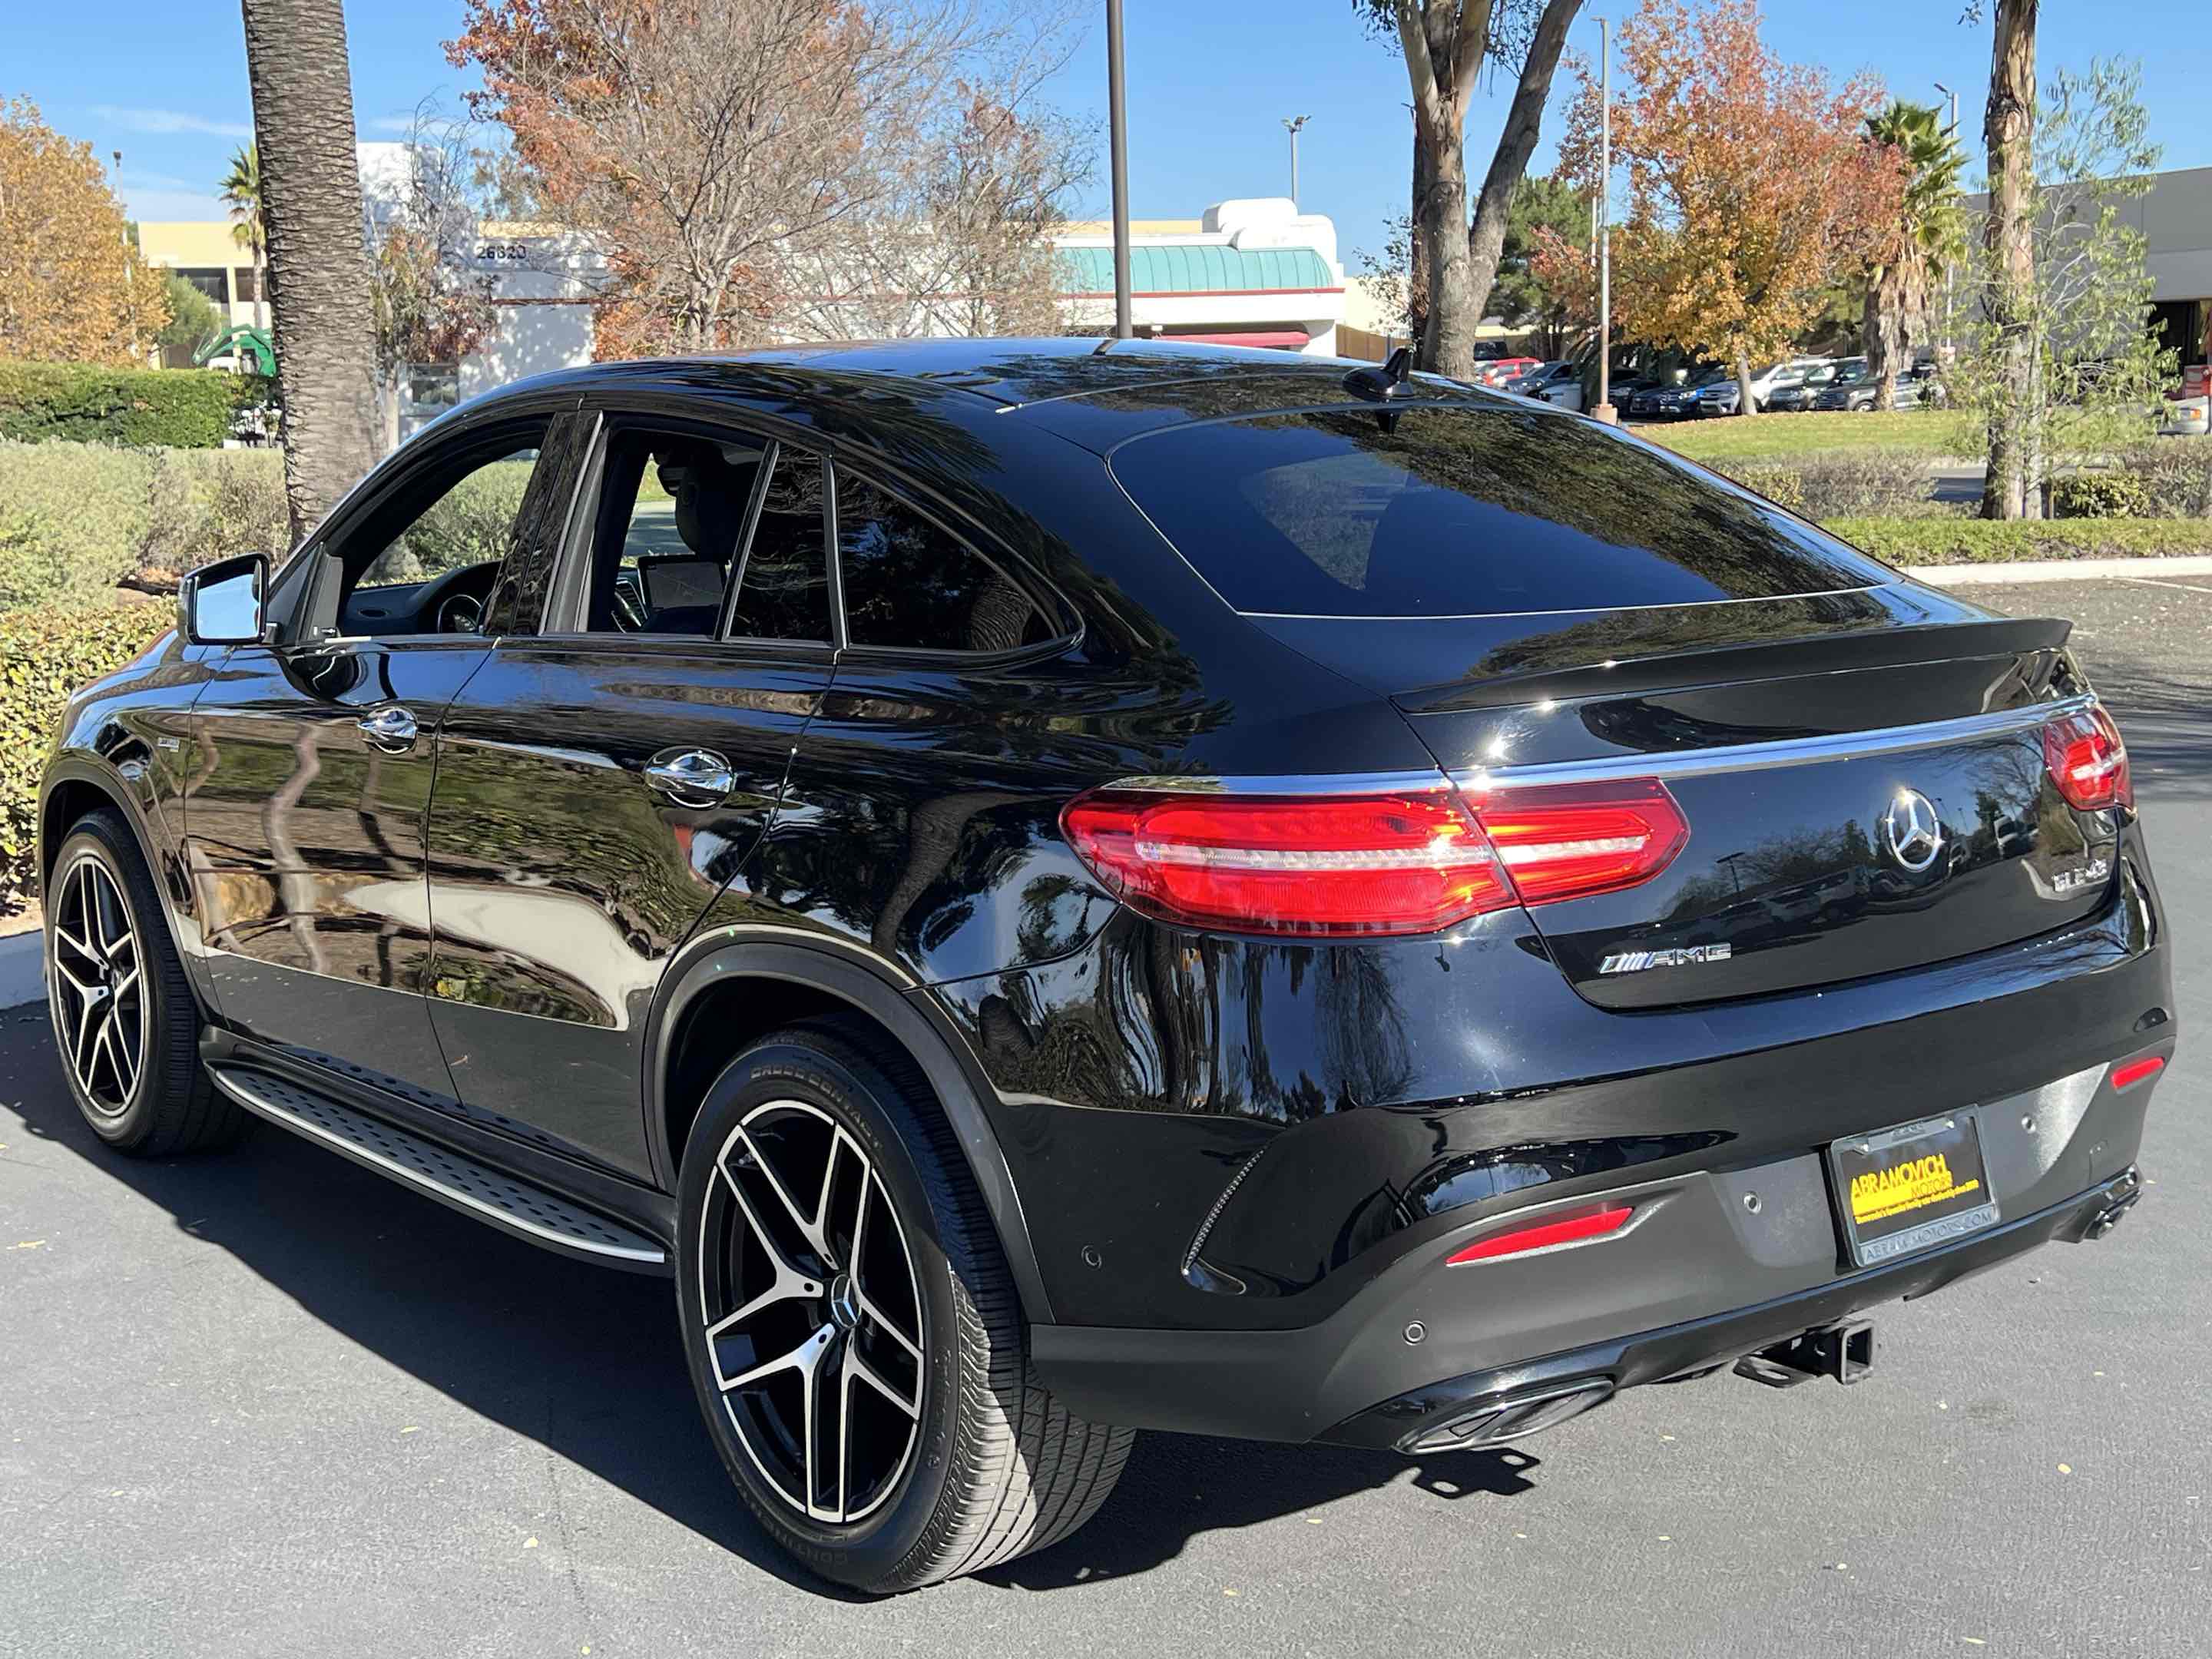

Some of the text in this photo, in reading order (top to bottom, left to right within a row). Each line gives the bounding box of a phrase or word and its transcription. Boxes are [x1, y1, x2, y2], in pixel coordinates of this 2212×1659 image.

[1644, 943, 1731, 969] AMG
[1851, 1153, 1947, 1197] ABRAMOVICH
[1911, 1175, 1952, 1197] MOTORS
